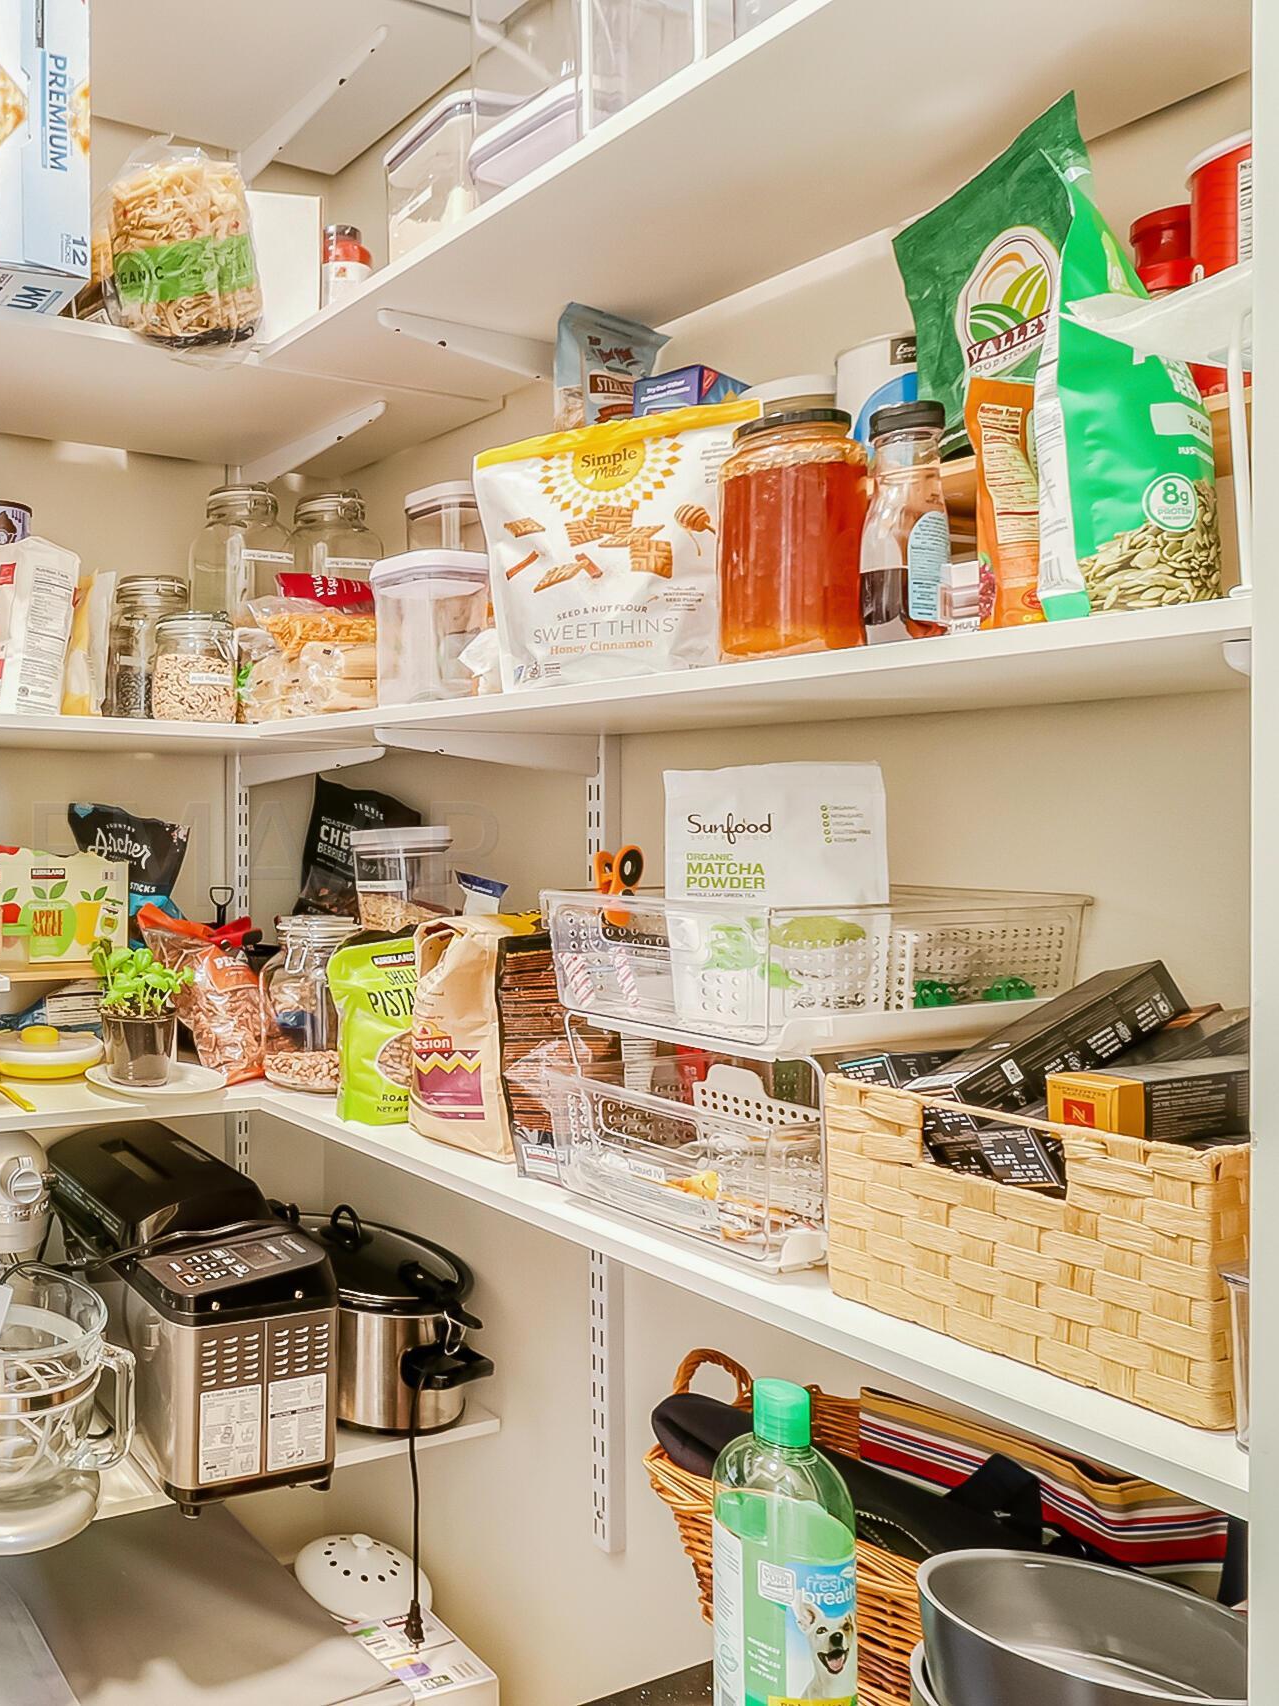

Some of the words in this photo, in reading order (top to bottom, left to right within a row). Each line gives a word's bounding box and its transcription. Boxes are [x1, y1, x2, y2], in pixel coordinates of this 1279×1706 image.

[49, 53, 68, 172] PREMIUM
[72, 236, 87, 266] 12
[968, 314, 1049, 362] VALLEY
[980, 406, 1003, 414] Nutrition
[580, 447, 638, 469] Simple
[591, 464, 630, 480] Mills
[1162, 481, 1189, 505] 8g
[557, 608, 580, 621] SEED
[583, 606, 589, 614] &
[592, 605, 612, 613] NUT
[614, 603, 648, 614] FLOUR
[533, 622, 600, 645] SWEET
[606, 617, 675, 637] THINS
[550, 643, 587, 655] Honey
[589, 638, 653, 652] Cinnamon
[687, 812, 772, 845] Sunfood
[87, 827, 152, 870] Archer
[317, 842, 348, 864] BERRIES
[686, 852, 734, 861] ORGANIC
[686, 862, 765, 875] MATCHA
[129, 881, 157, 894] STICKS
[686, 876, 765, 889] POWDER
[32, 910, 63, 922] APPLE
[32, 922, 63, 937] SAUCE
[413, 1037, 451, 1050] ssion
[376, 1105, 392, 1113] NET
[806, 1575, 846, 1594] fresh
